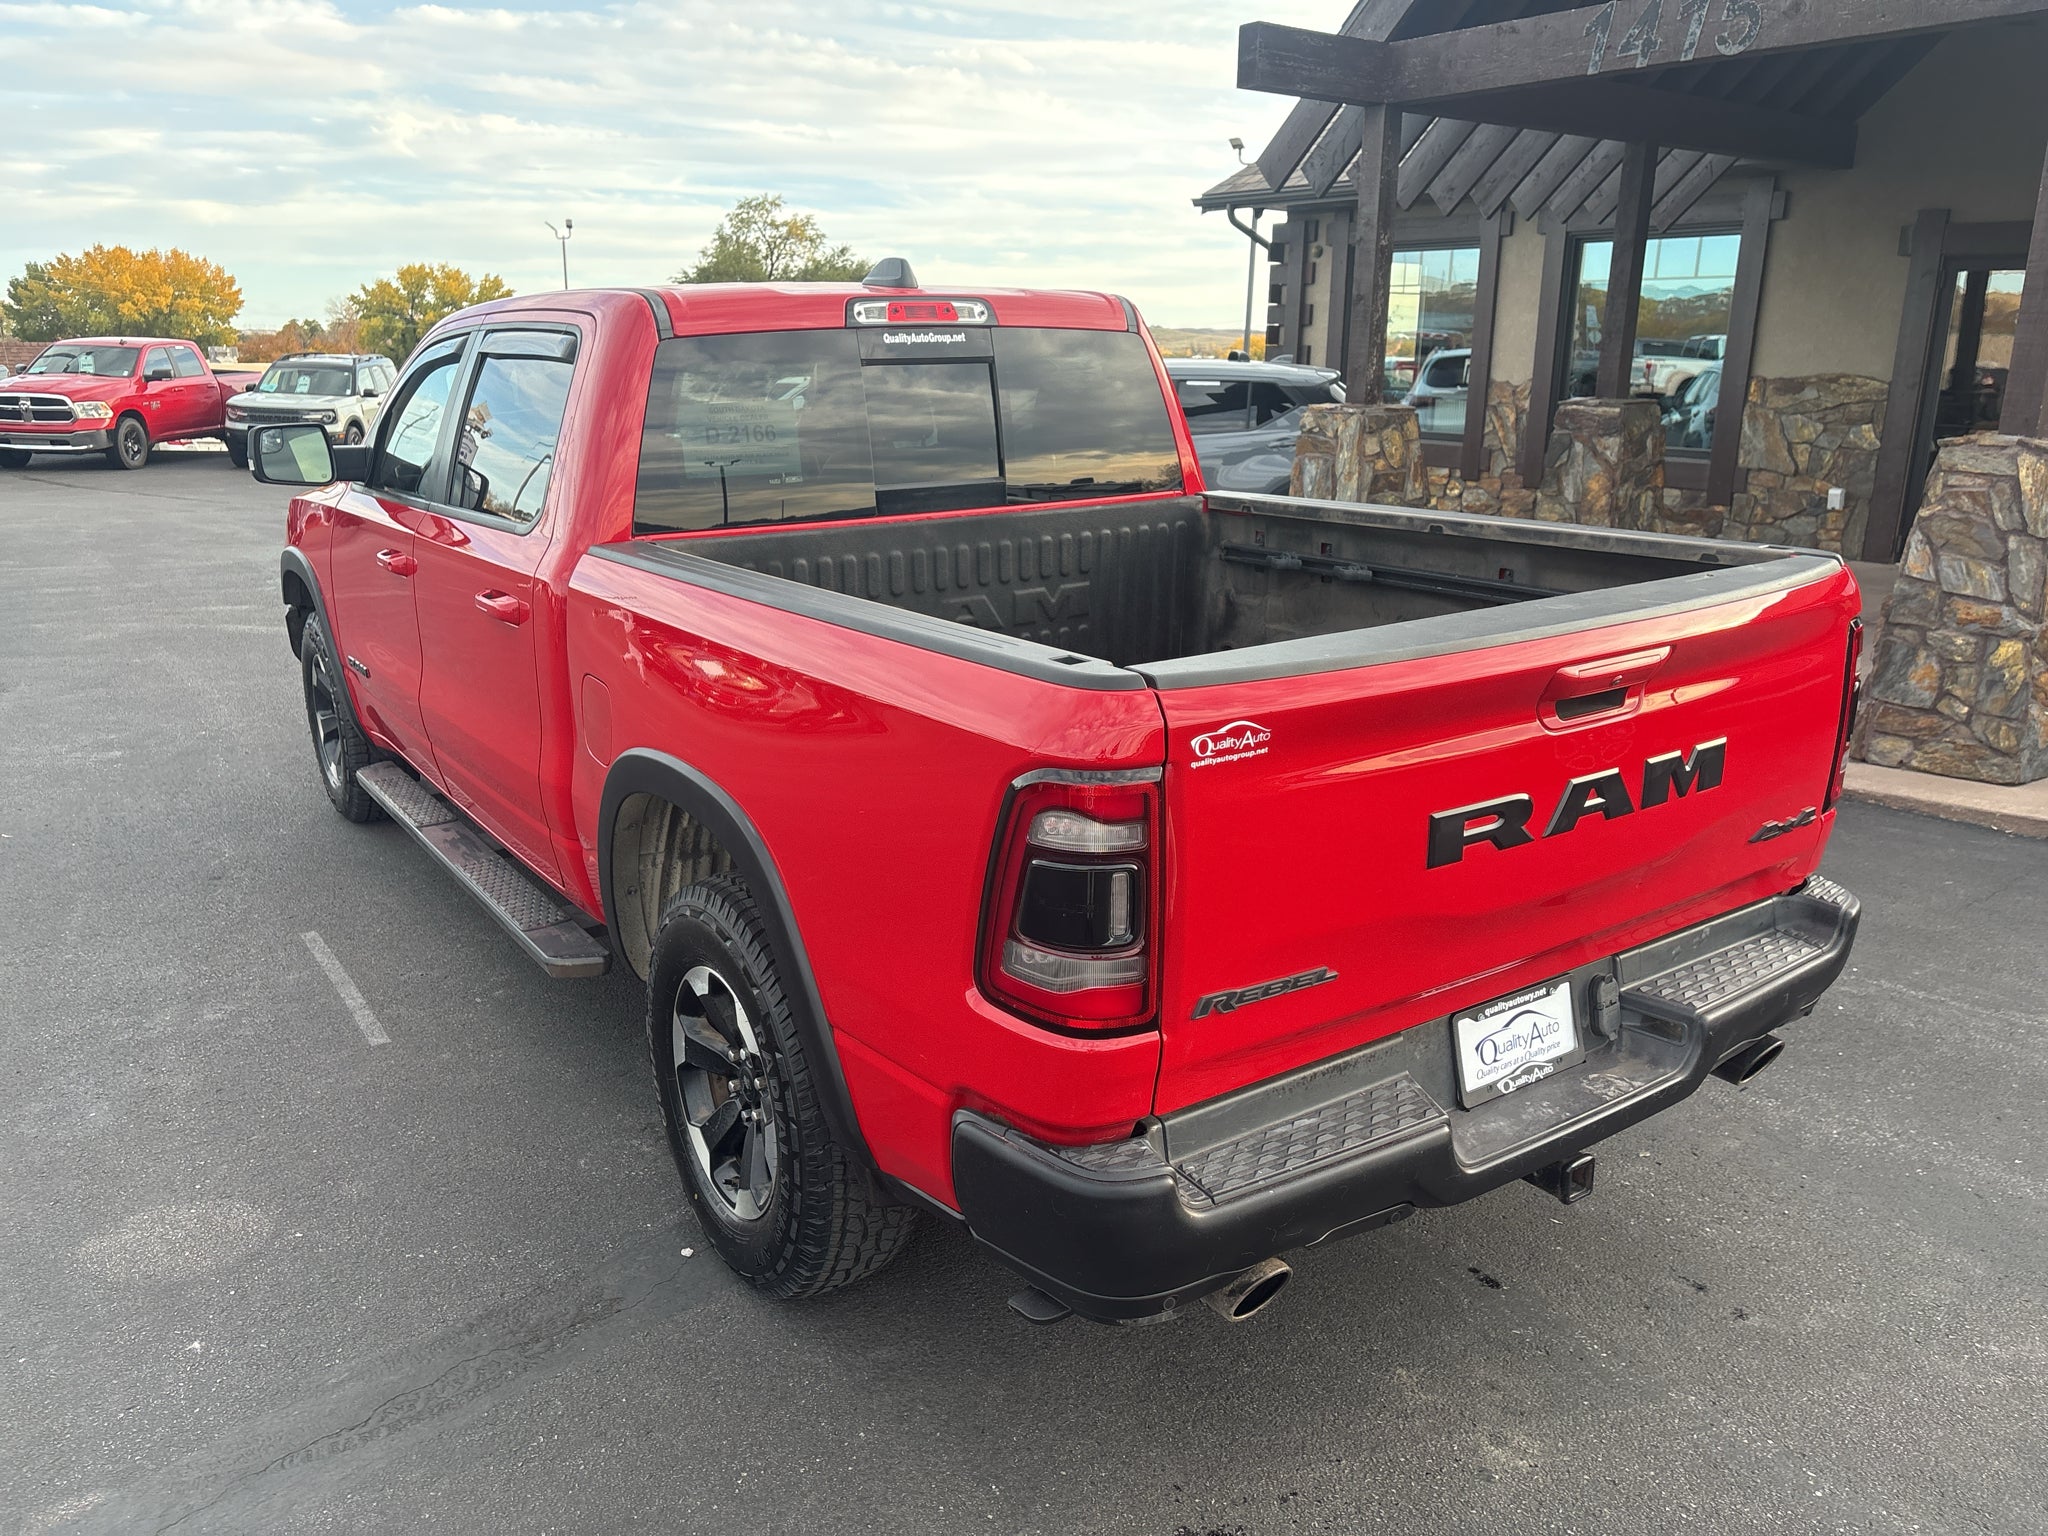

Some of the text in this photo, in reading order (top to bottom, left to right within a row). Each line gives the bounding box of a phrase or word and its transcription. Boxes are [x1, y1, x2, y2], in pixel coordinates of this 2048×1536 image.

[883, 332, 966, 345] QualityAutoGroup.net
[728, 424, 777, 443] 2166
[1190, 747, 1269, 770] qualityautogroup.net
[1195, 730, 1271, 757] QualityAuto
[1426, 736, 1728, 870] RAM
[1191, 966, 1339, 1020] REBEL
[1484, 987, 1547, 1017] qualityautowy.net
[1480, 1021, 1560, 1066] QualityAuto
[1476, 1065, 1499, 1080] Quality
[1500, 1059, 1513, 1070] cars
[1524, 1046, 1546, 1062] Quality
[1546, 1041, 1561, 1055] price
[755, 1024, 790, 1156] RADIAL
[1499, 1065, 1555, 1094] QualityAuto
